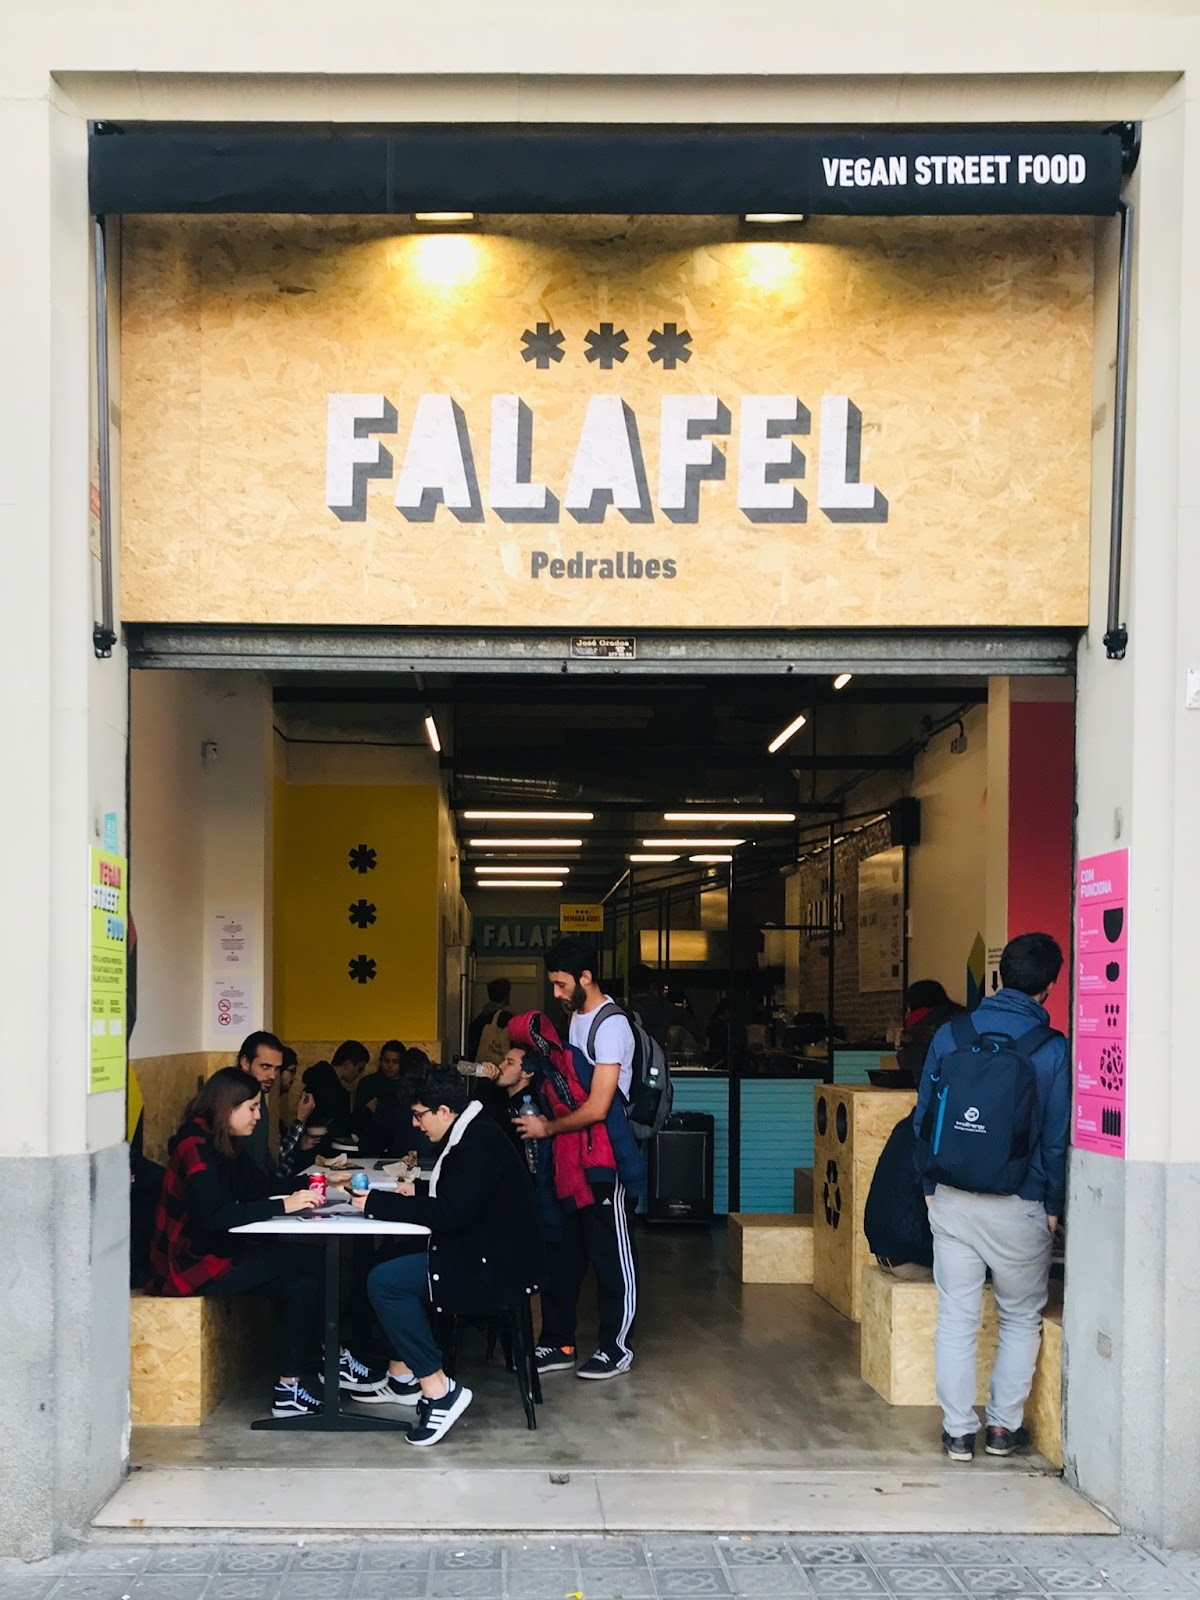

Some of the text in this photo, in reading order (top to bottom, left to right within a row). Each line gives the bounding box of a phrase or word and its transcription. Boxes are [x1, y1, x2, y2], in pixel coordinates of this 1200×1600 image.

[822, 154, 1086, 186] VEGAN STREET FOOD
[326, 393, 889, 523] FALAFEL
[531, 551, 677, 579] Pedralbes
[1081, 869, 1095, 882] COM
[1080, 880, 1112, 899] FUNCIONA
[483, 925, 580, 947] FALAF
